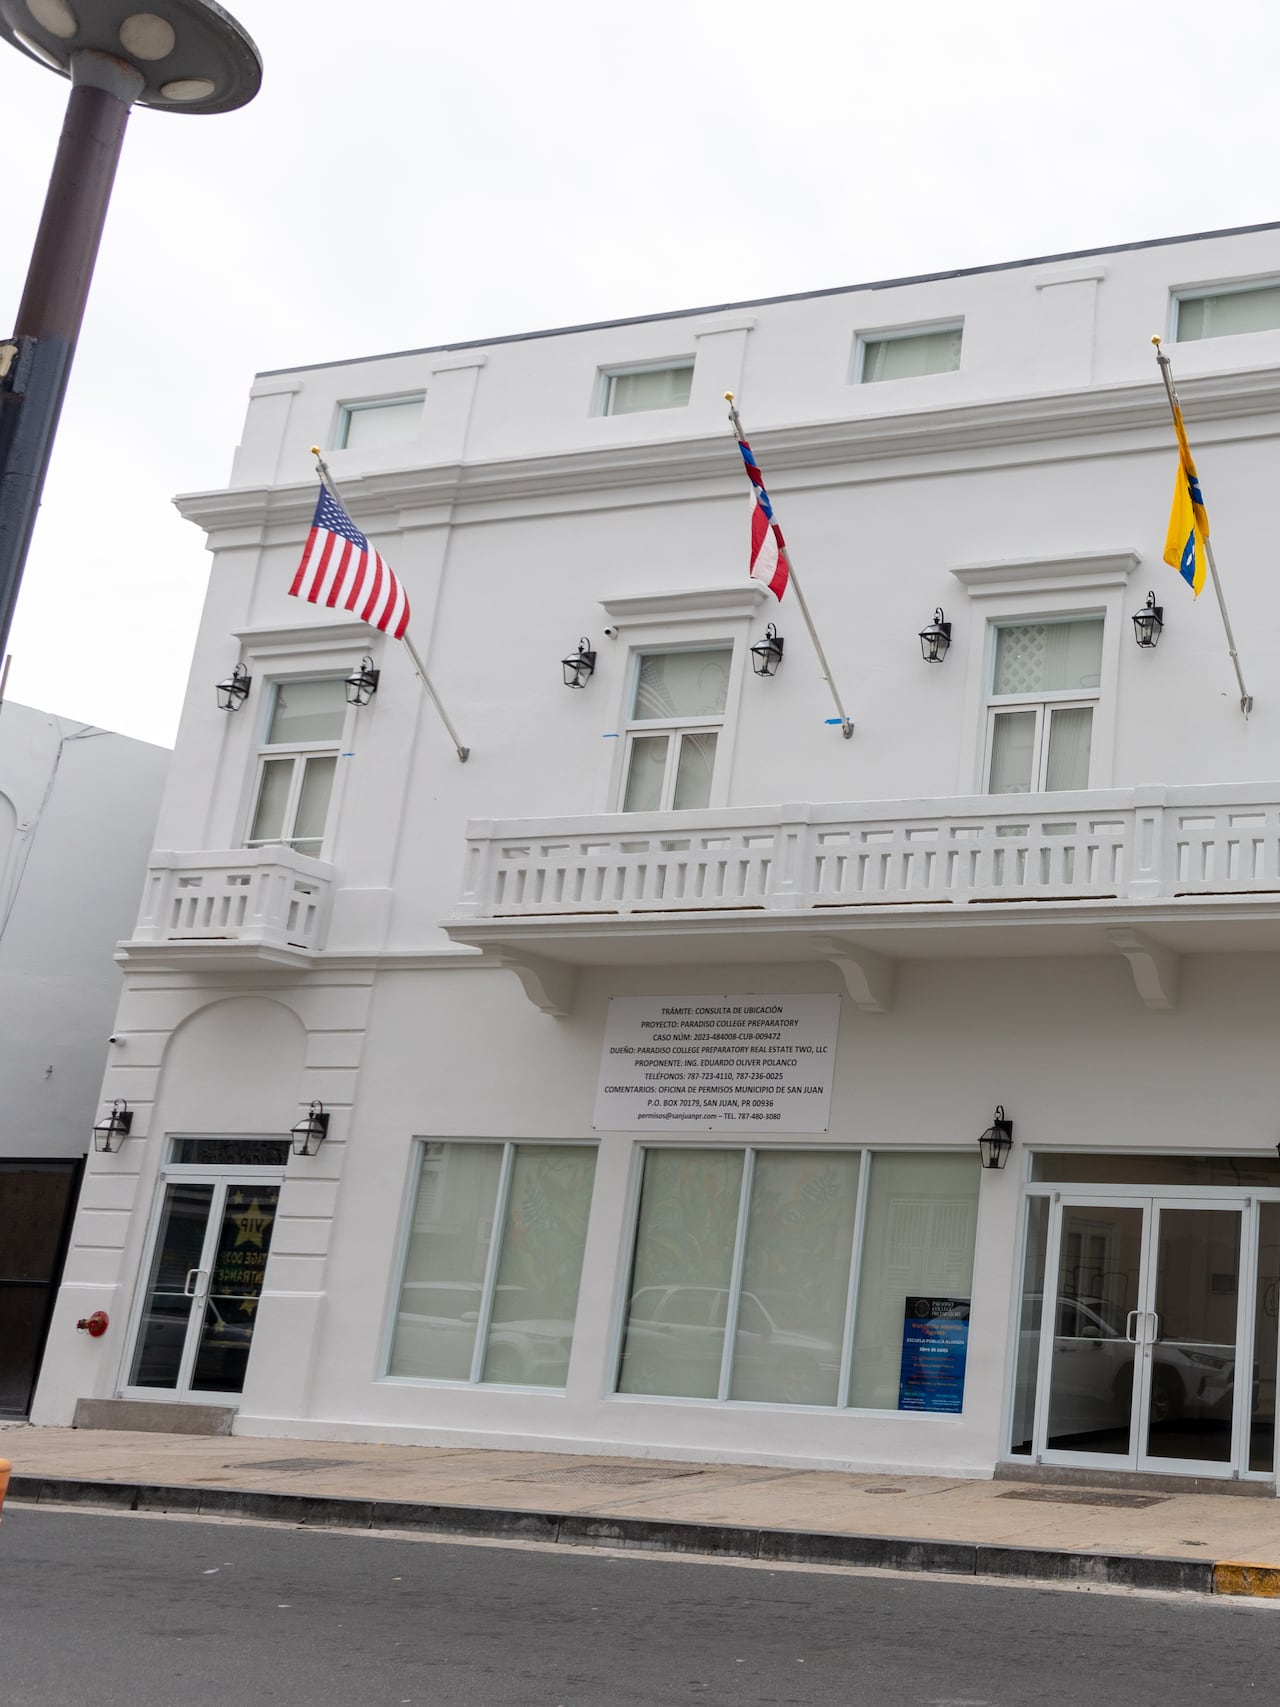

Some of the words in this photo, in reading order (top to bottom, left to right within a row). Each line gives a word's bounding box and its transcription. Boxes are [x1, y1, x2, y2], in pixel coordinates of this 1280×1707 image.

[662, 1007, 693, 1015] TRÁMITE:
[744, 1006, 782, 1014] UBICACIÓN
[673, 1032, 692, 1041] NÚM:
[610, 1046, 636, 1054] DUEÑO:
[795, 1046, 814, 1054] TWO,
[645, 1072, 685, 1080] TELÉFONOS:
[688, 1073, 734, 1081] 787-723-4110,
[719, 1100, 740, 1108] JUAN,
[638, 1112, 717, 1121] permisos@sanjuanpr.com
